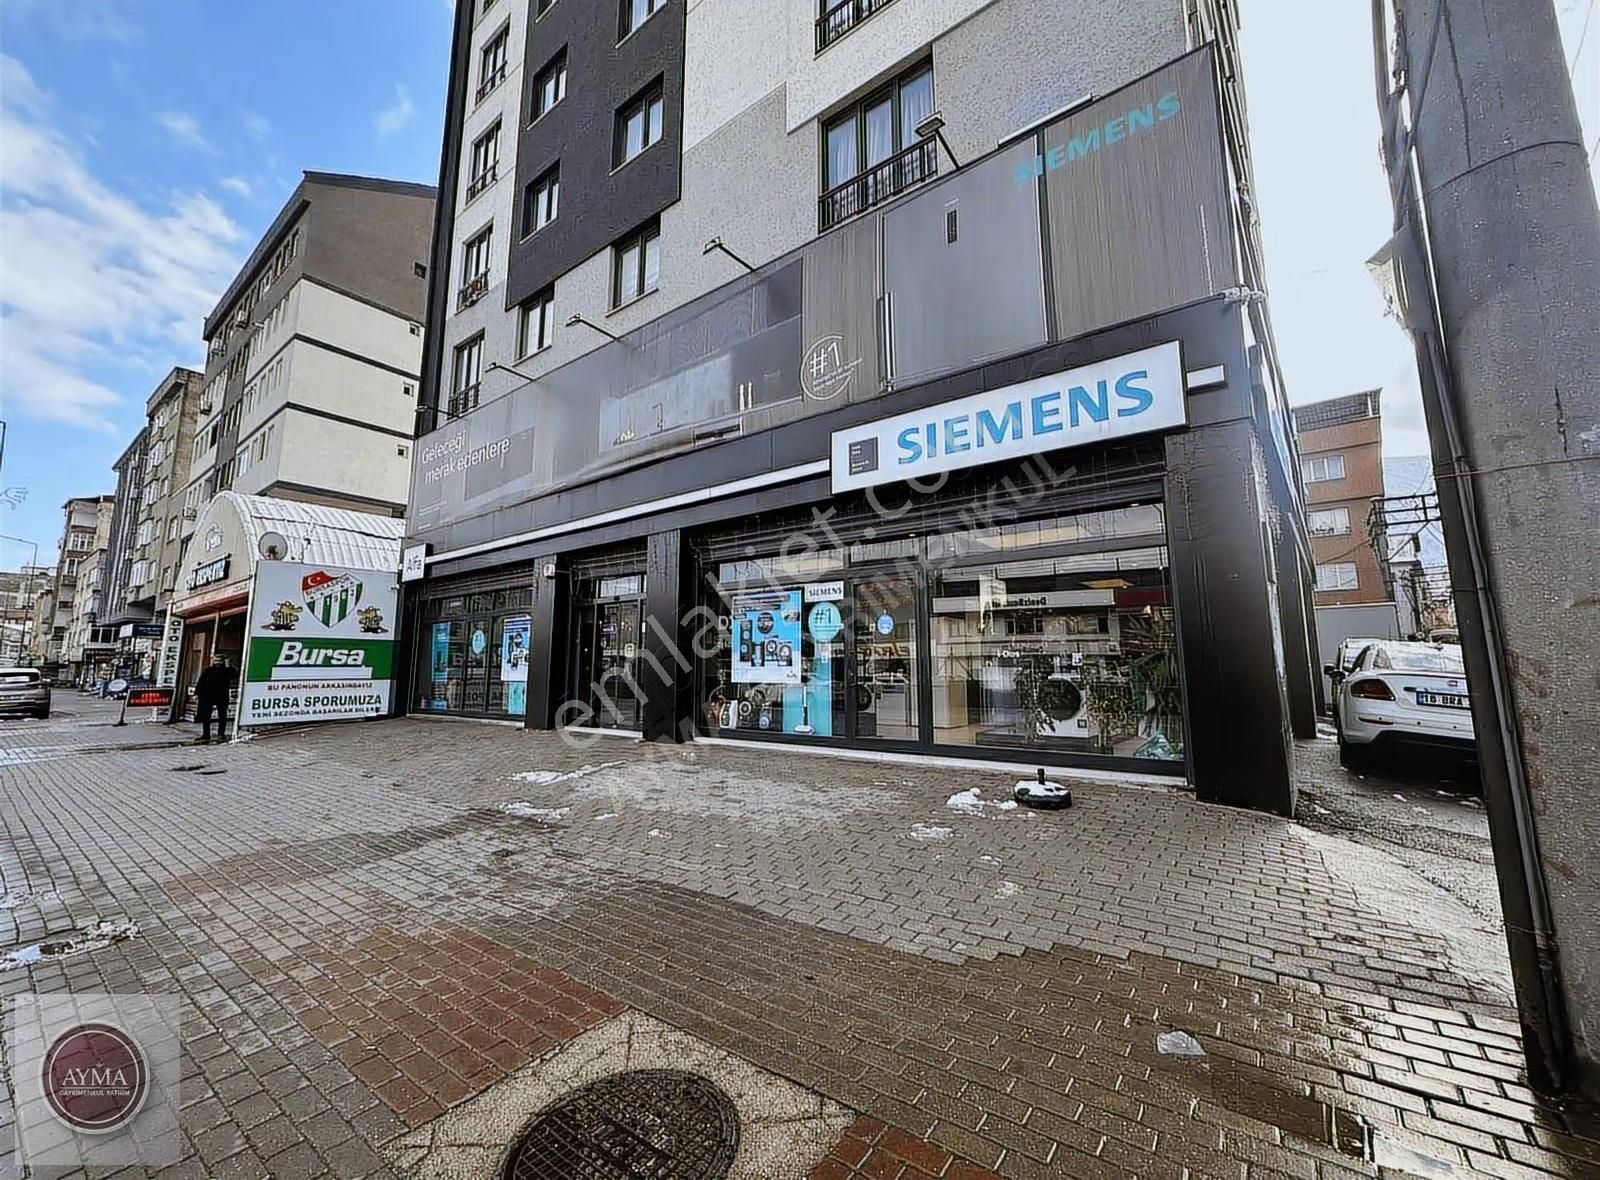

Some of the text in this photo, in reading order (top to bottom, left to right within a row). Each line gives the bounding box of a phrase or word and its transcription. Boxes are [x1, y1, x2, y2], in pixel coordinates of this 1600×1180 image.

[1014, 92, 1182, 187] SIEMENS
[810, 341, 840, 377] #1
[897, 369, 1155, 465] SIEMENS
[809, 586, 842, 597] SIEMENS
[815, 607, 832, 624] #1
[167, 620, 181, 642] OTO
[276, 641, 365, 666] Bursa
[252, 694, 382, 711] BURSA SPORUMUZA
